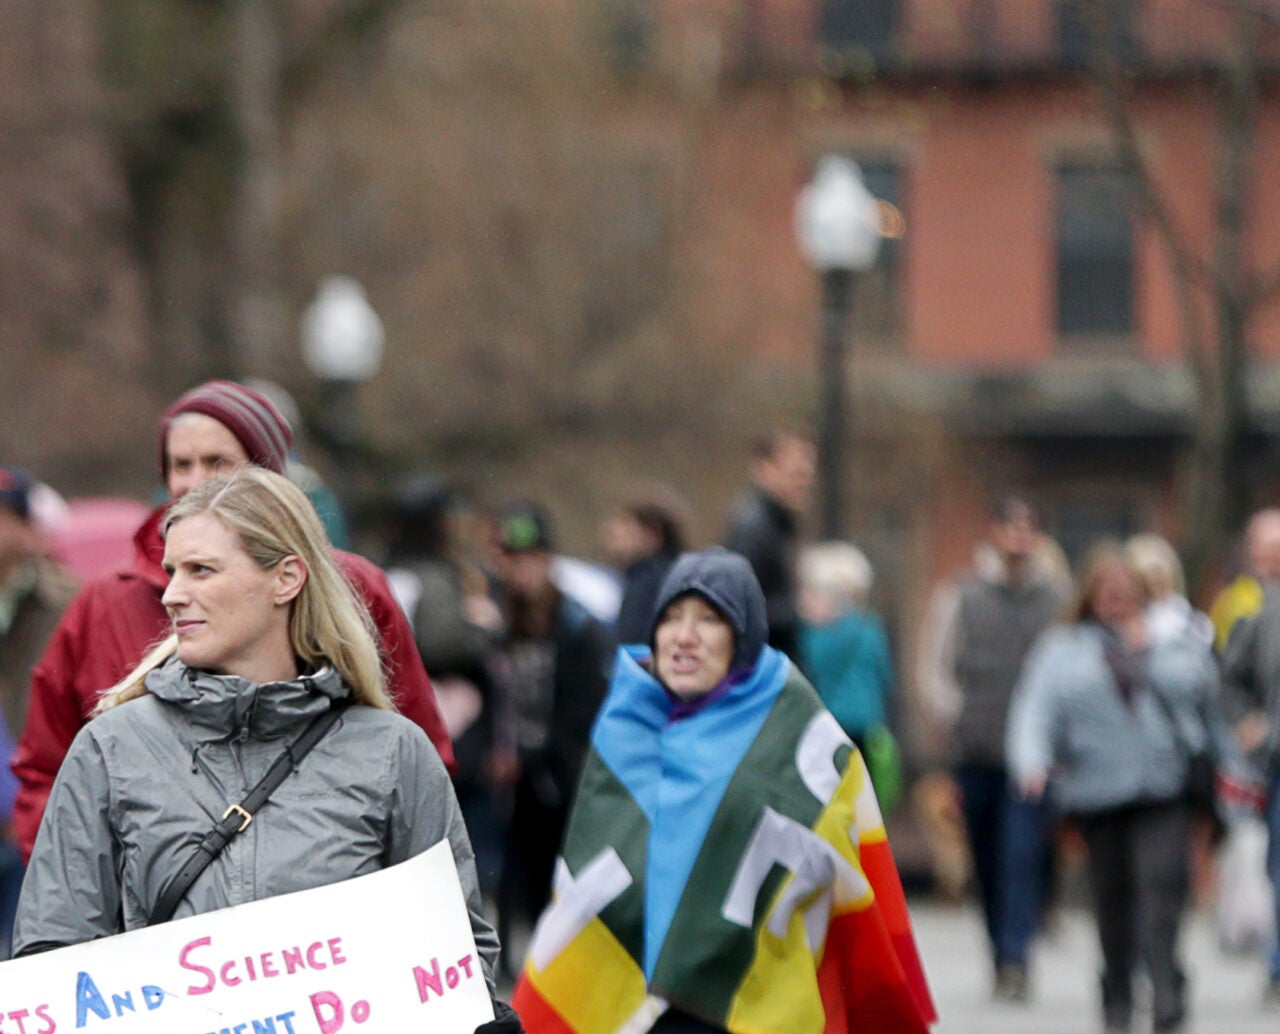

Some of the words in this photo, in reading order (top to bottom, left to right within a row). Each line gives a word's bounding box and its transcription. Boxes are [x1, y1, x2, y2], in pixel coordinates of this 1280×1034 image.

[76, 971, 165, 1028] AND
[179, 935, 347, 995] SCIENCE
[412, 953, 474, 1004] NOT
